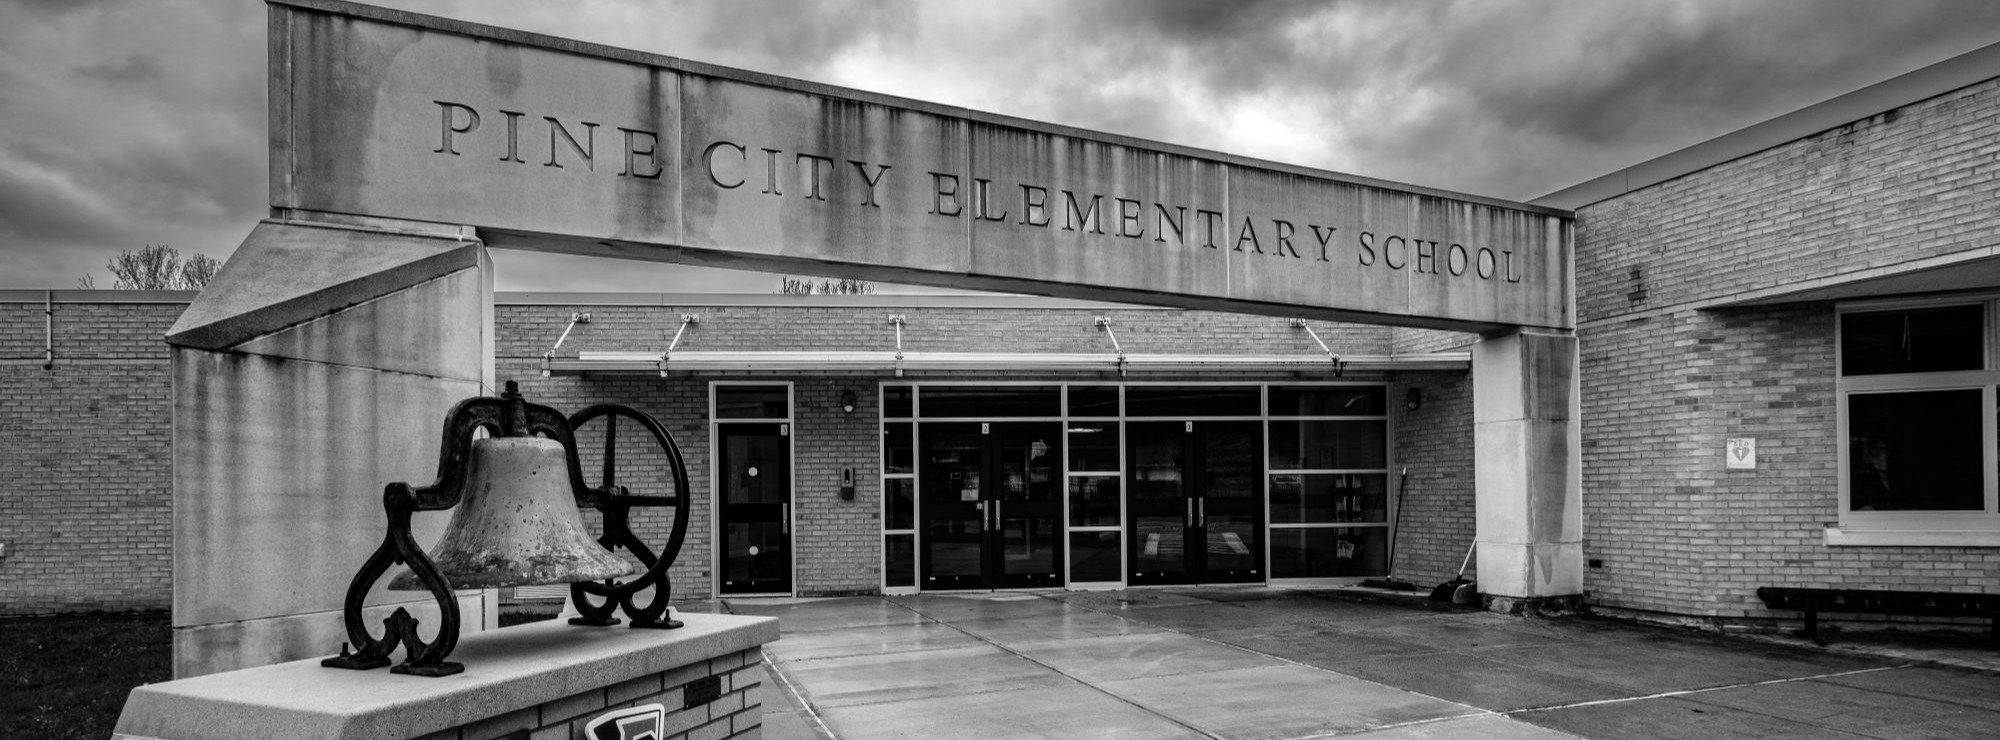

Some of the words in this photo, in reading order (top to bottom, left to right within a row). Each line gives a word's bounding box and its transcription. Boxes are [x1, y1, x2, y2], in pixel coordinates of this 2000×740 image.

[433, 99, 663, 180] PINE
[700, 140, 893, 208] CITY
[927, 172, 1336, 263] ELEMENTARY
[1358, 231, 1522, 284] SCHOOL
